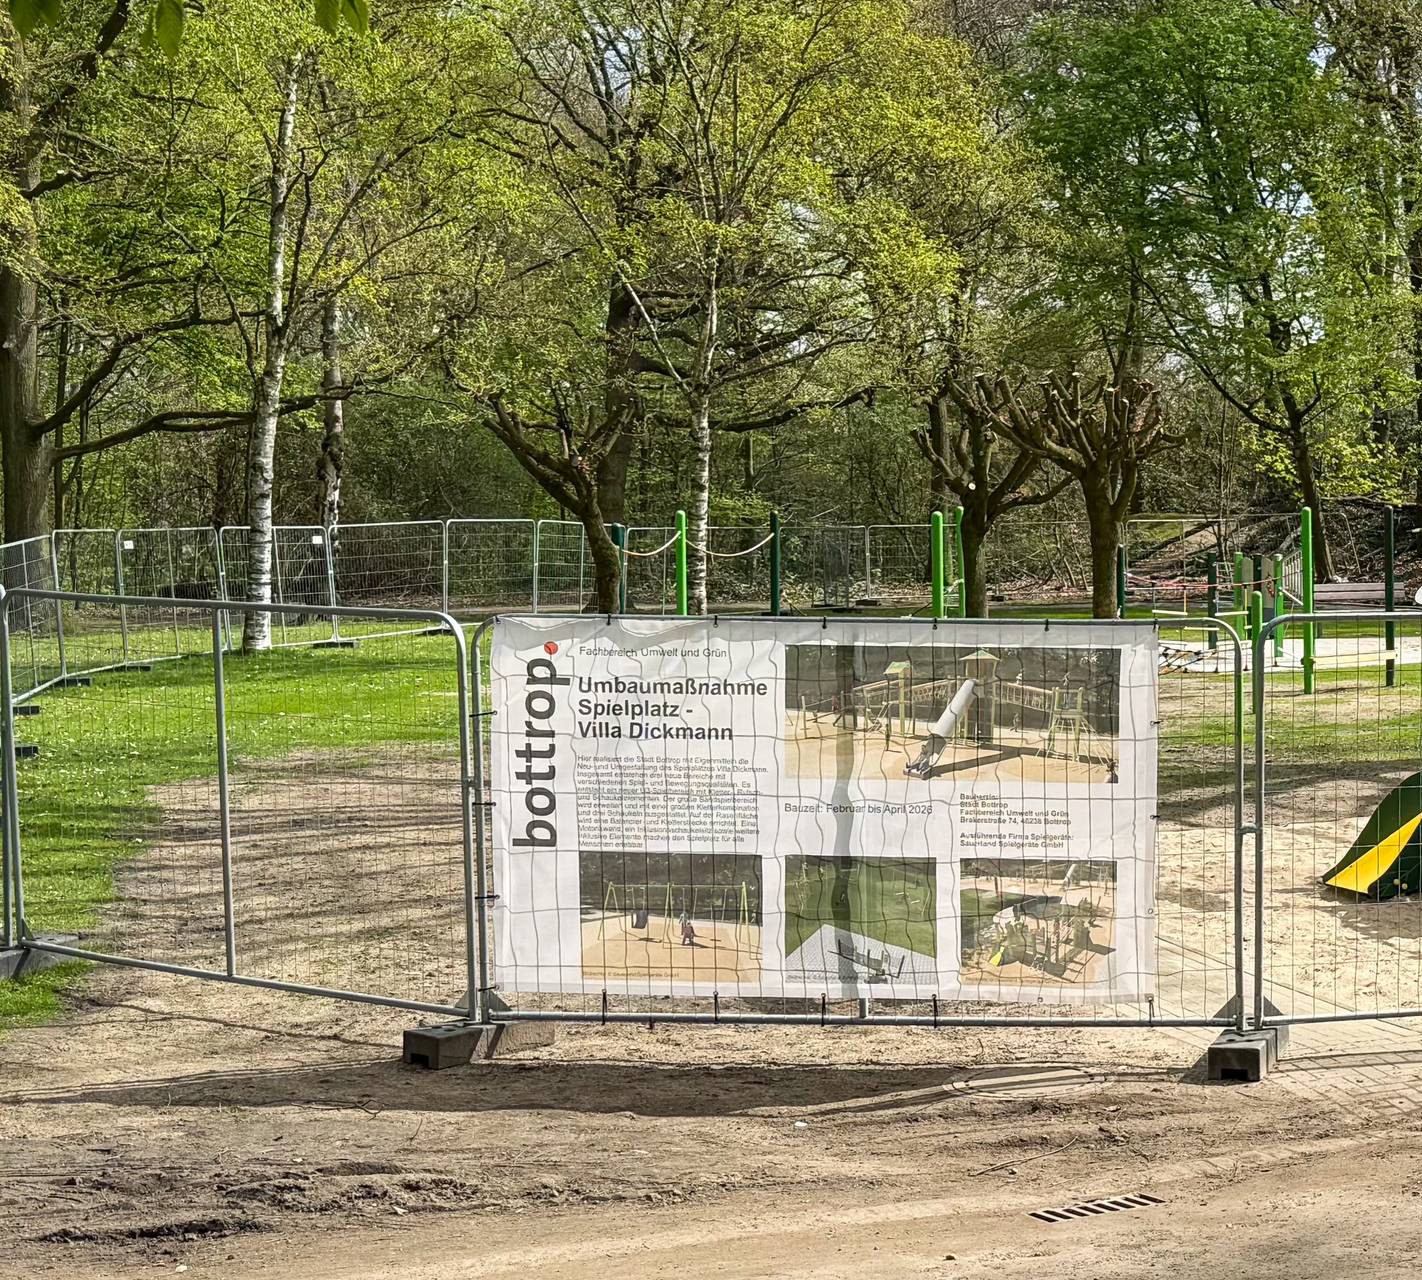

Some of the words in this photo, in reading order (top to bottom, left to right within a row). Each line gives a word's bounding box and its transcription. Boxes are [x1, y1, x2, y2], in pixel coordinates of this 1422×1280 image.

[579, 646, 638, 657] Fachbereich
[641, 648, 678, 657] Umwelt
[681, 649, 699, 657] und
[703, 648, 727, 658] Grün
[578, 676, 767, 696] Umbaumaßnahme
[578, 698, 680, 720] Spielplatz
[578, 721, 622, 739] Villa
[629, 722, 733, 740] Dickmann
[784, 803, 823, 813] Bauzeit:
[826, 803, 865, 813] Februar
[868, 803, 881, 813] bis
[884, 804, 905, 816] April
[909, 805, 933, 814] 2026
